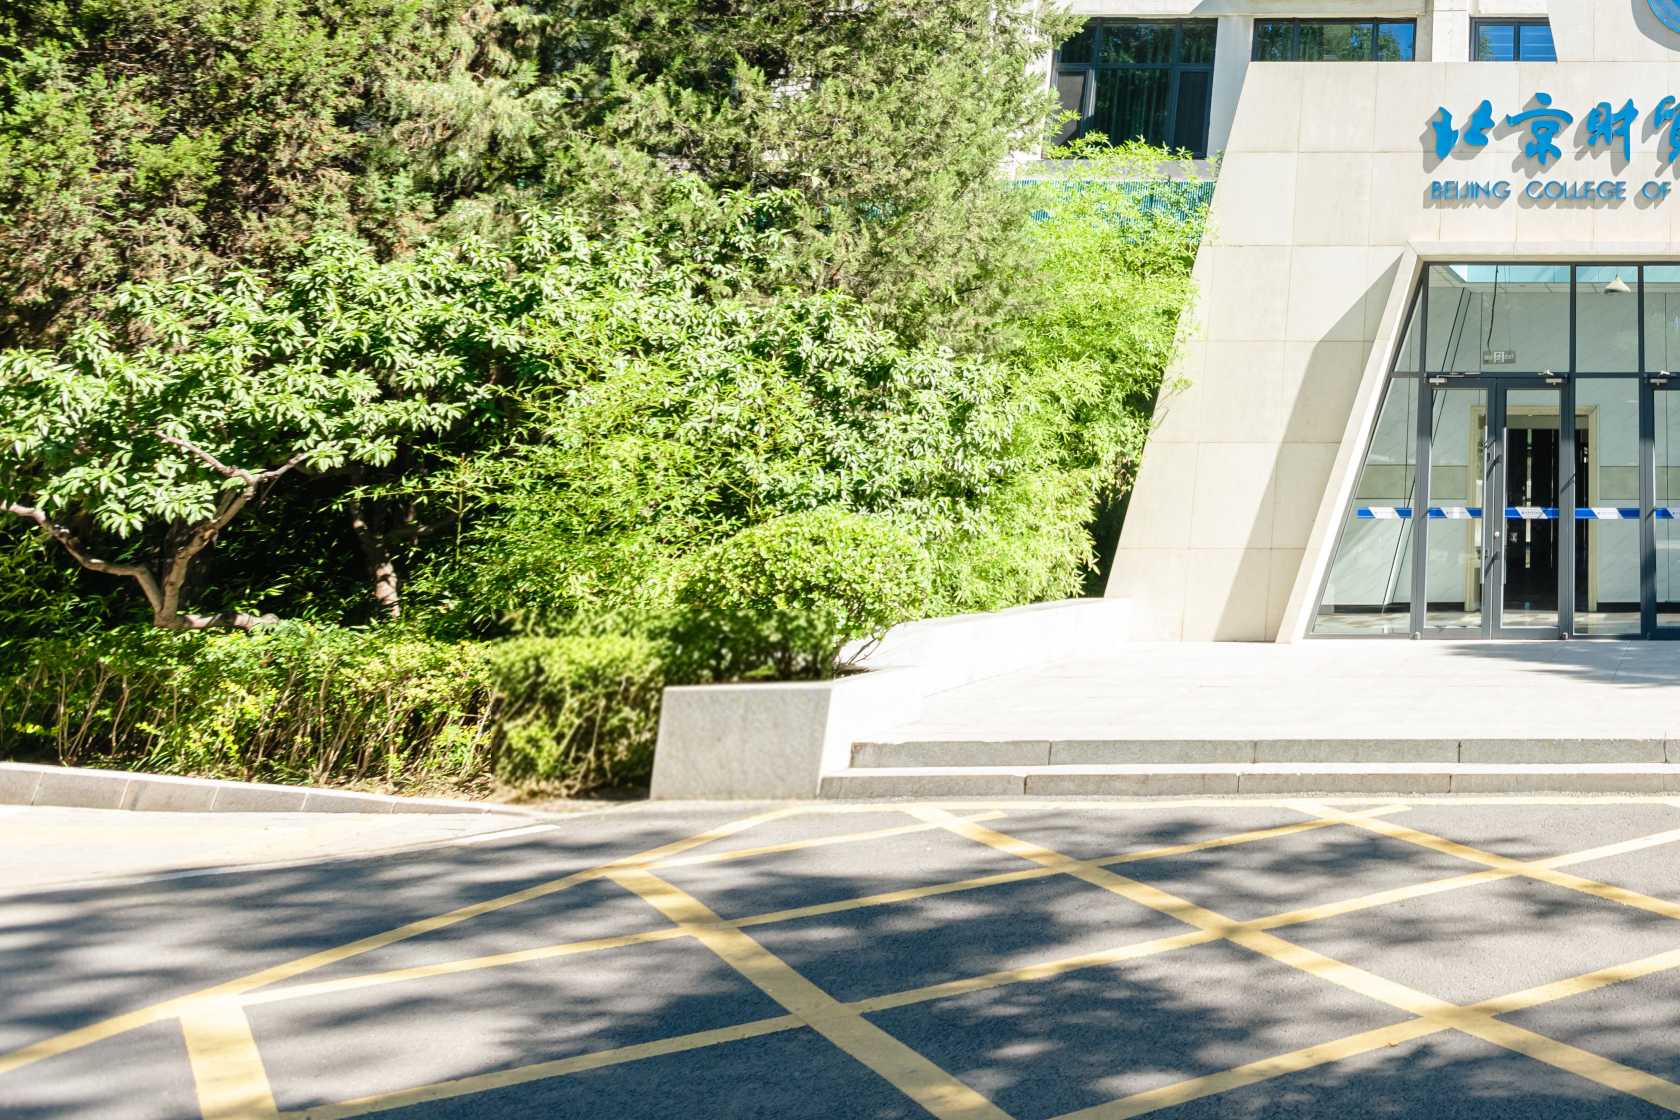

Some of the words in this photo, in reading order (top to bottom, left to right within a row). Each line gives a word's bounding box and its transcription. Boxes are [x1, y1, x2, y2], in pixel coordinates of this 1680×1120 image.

[1430, 180, 1511, 200] BEIJING
[1525, 180, 1626, 200] COLLEGE
[1642, 180, 1671, 200] OF
